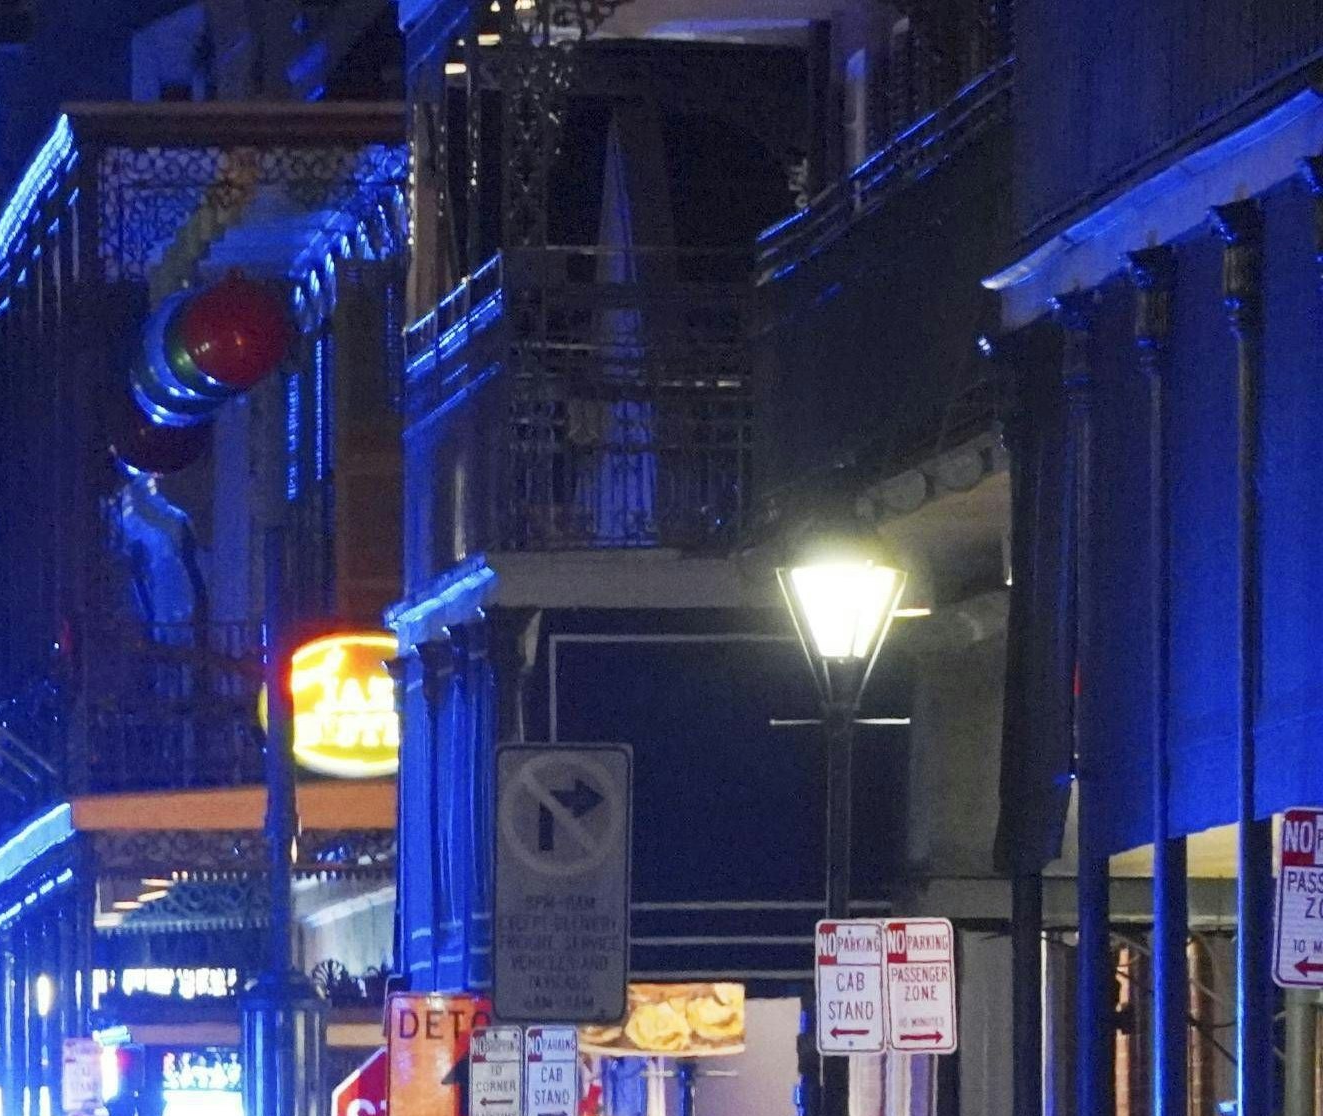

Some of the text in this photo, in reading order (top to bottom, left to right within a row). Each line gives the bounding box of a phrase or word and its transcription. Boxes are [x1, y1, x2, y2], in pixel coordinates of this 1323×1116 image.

[1285, 820, 1313, 853] NO
[819, 933, 881, 956] NO PARKING
[887, 929, 949, 954] NO PARKING
[836, 971, 865, 992] CAB
[891, 967, 948, 982] PASSENGER
[905, 985, 937, 1002] ZONE
[828, 1001, 874, 1021] STAND
[541, 1067, 564, 1083] CAB
[476, 1080, 516, 1092] CORNER
[535, 1088, 570, 1106] STAND
